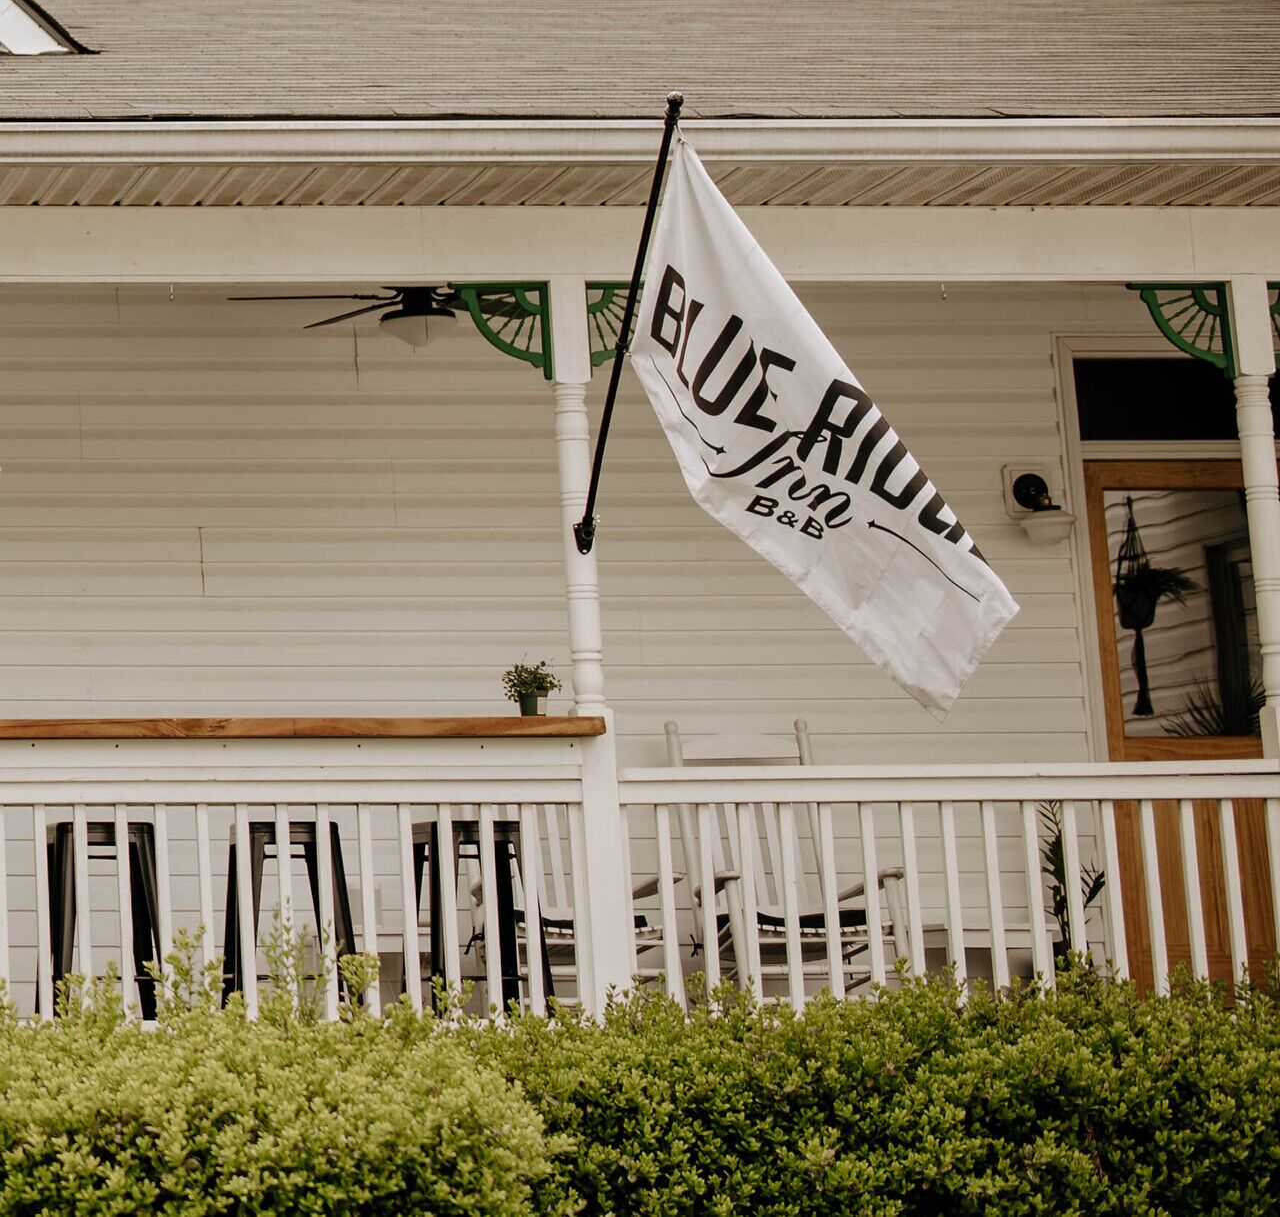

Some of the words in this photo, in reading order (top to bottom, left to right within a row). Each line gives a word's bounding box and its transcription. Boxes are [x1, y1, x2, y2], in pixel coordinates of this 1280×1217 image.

[650, 264, 796, 433] BLUE
[701, 429, 853, 530] Inn
[746, 494, 827, 541] B&B
